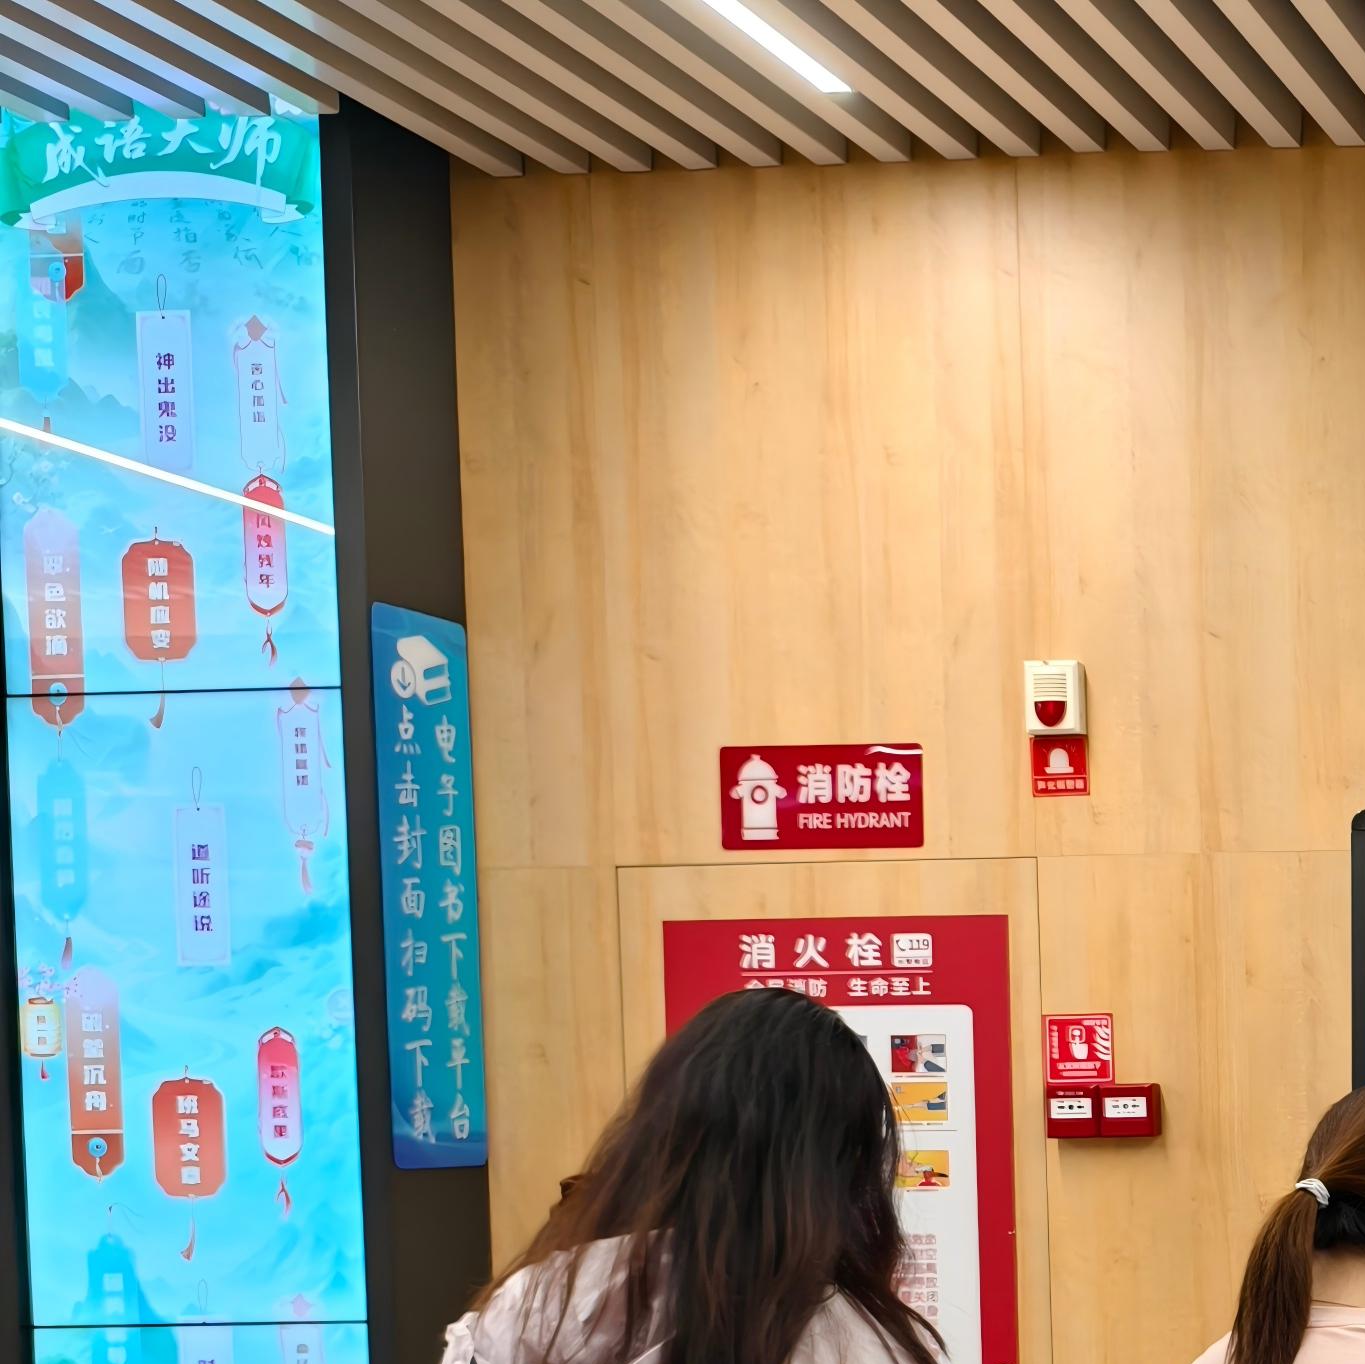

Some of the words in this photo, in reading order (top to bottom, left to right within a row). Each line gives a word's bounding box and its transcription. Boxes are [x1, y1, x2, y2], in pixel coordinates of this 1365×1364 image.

[41, 115, 284, 190] 成语大师
[796, 762, 912, 804] 消防栓
[797, 813, 832, 830] FIRE
[835, 811, 912, 830] HYDRANT
[392, 705, 438, 1145] 点击封面扫码下载
[435, 714, 474, 1142] 电子图书下载平台
[738, 932, 883, 970] 消火栓
[847, 976, 932, 997] 生命至上
